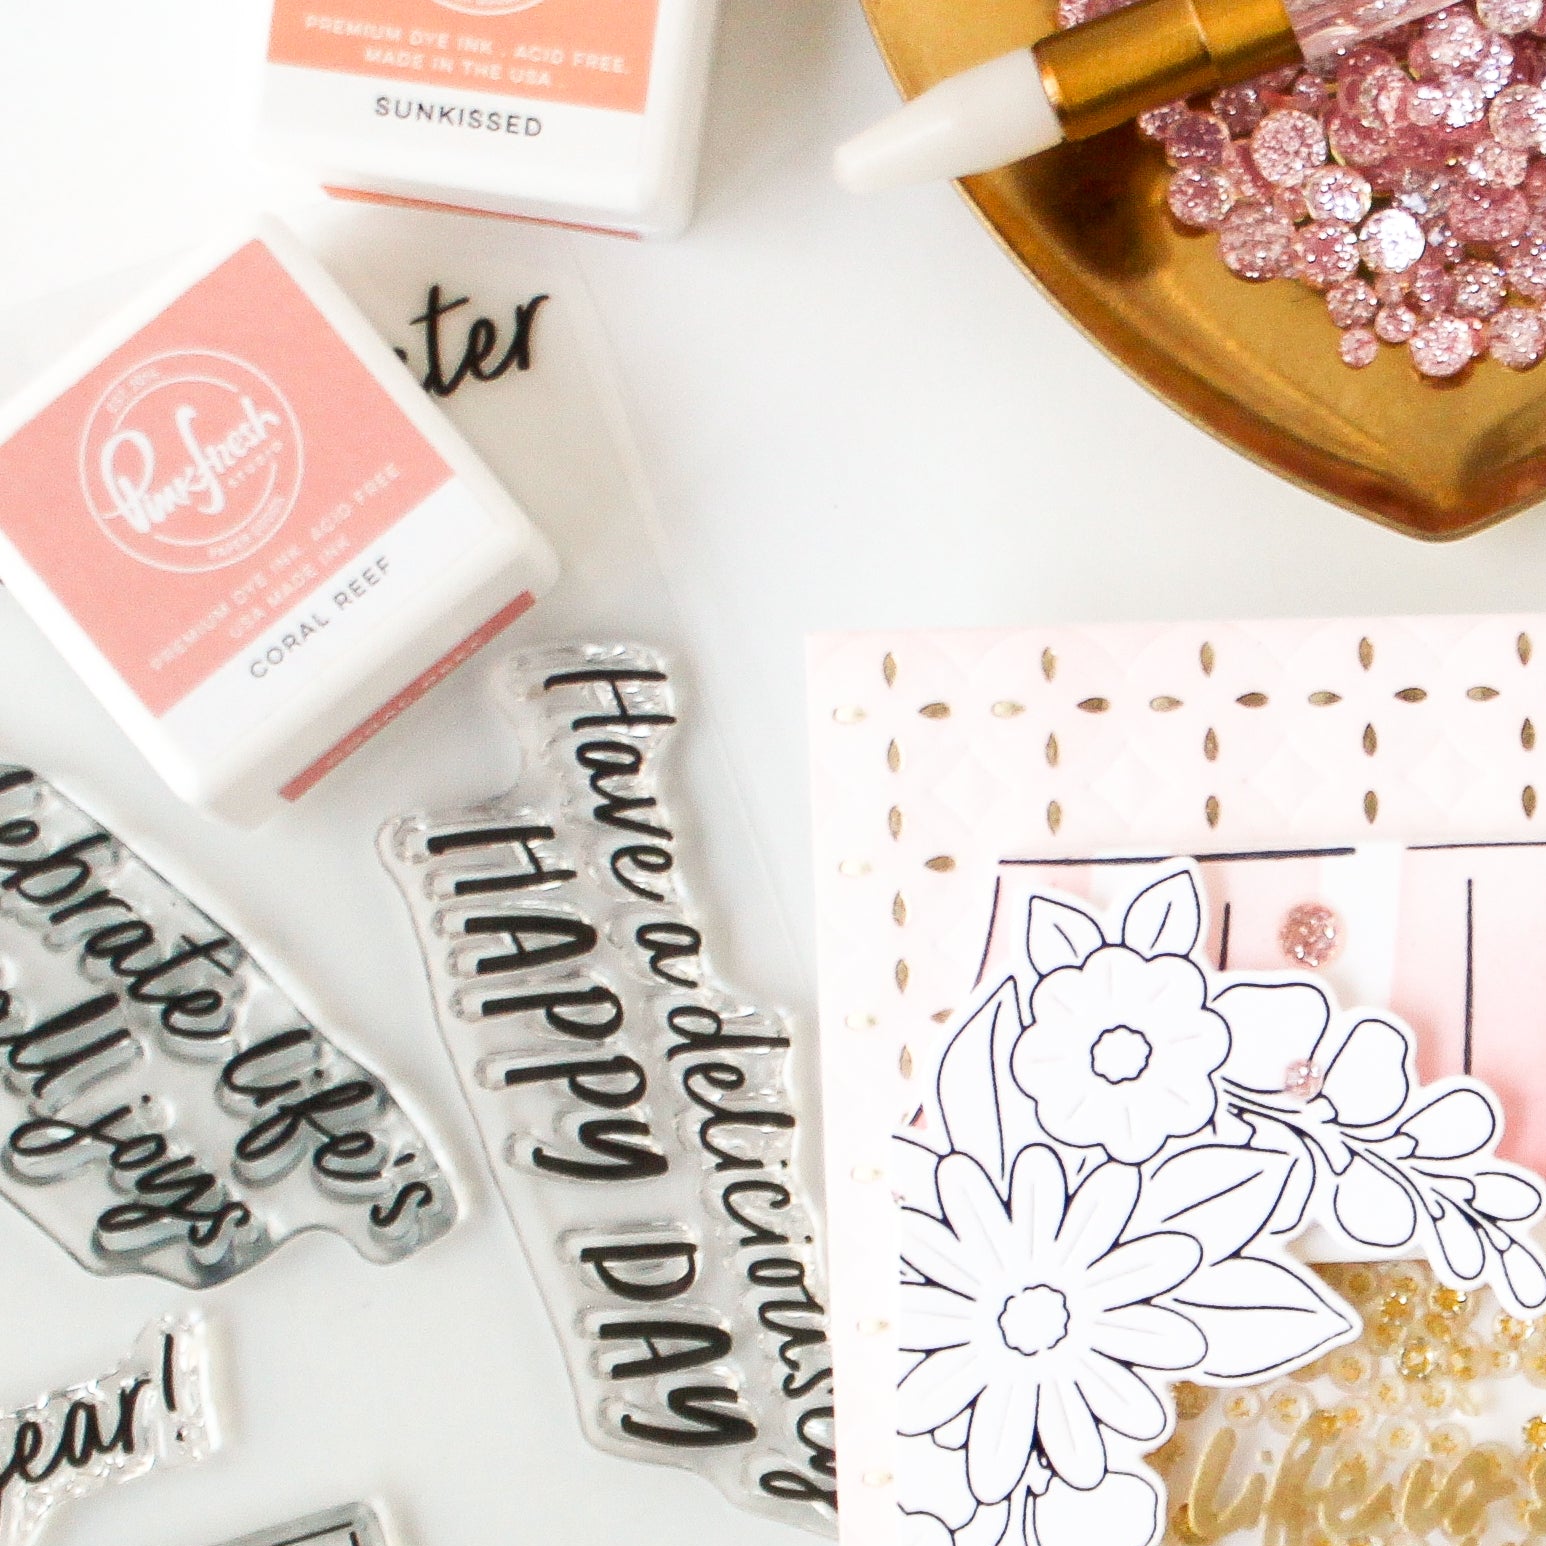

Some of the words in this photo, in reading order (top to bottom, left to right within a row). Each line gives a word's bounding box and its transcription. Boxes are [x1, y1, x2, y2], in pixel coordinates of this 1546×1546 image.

[304, 14, 403, 41] PREMIUM
[408, 30, 450, 49] DYE
[514, 46, 564, 65] ACID
[364, 47, 425, 70] MADE
[431, 56, 453, 73] IN
[462, 60, 502, 80] THE
[509, 68, 552, 86] USA
[374, 95, 543, 138] SUNKISSED
[394, 283, 550, 397] ter
[250, 613, 331, 679] CORAL
[333, 555, 391, 610] REEF
[543, 669, 676, 902] Have
[636, 921, 702, 988] a
[9, 1094, 252, 1248] joys
[222, 1028, 434, 1228] life's
